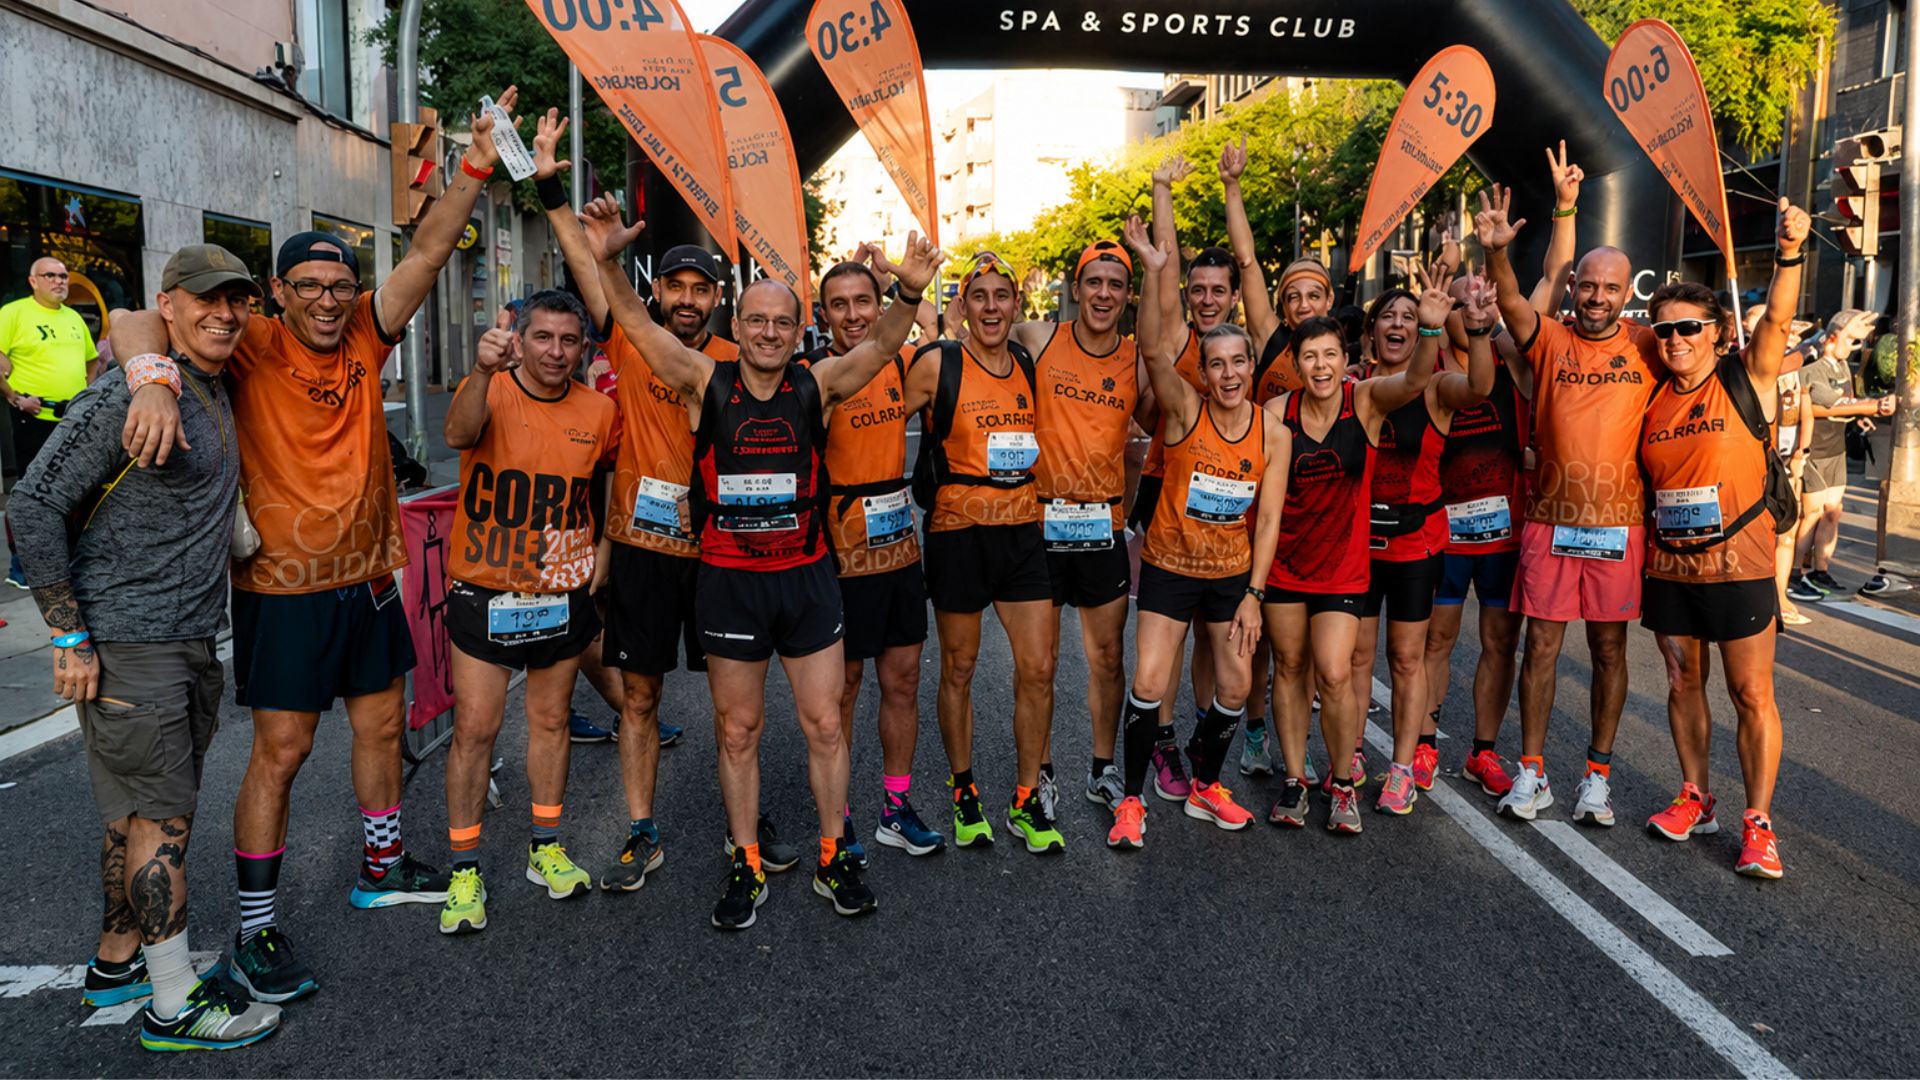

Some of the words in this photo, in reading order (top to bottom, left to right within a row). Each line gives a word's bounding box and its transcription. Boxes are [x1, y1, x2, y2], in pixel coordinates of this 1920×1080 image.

[1000, 10, 1061, 31] SPA
[1081, 11, 1101, 32] &
[1121, 12, 1250, 36] SPORTS
[1269, 17, 1356, 38] CLUB
[1423, 71, 1483, 138] 5:30
